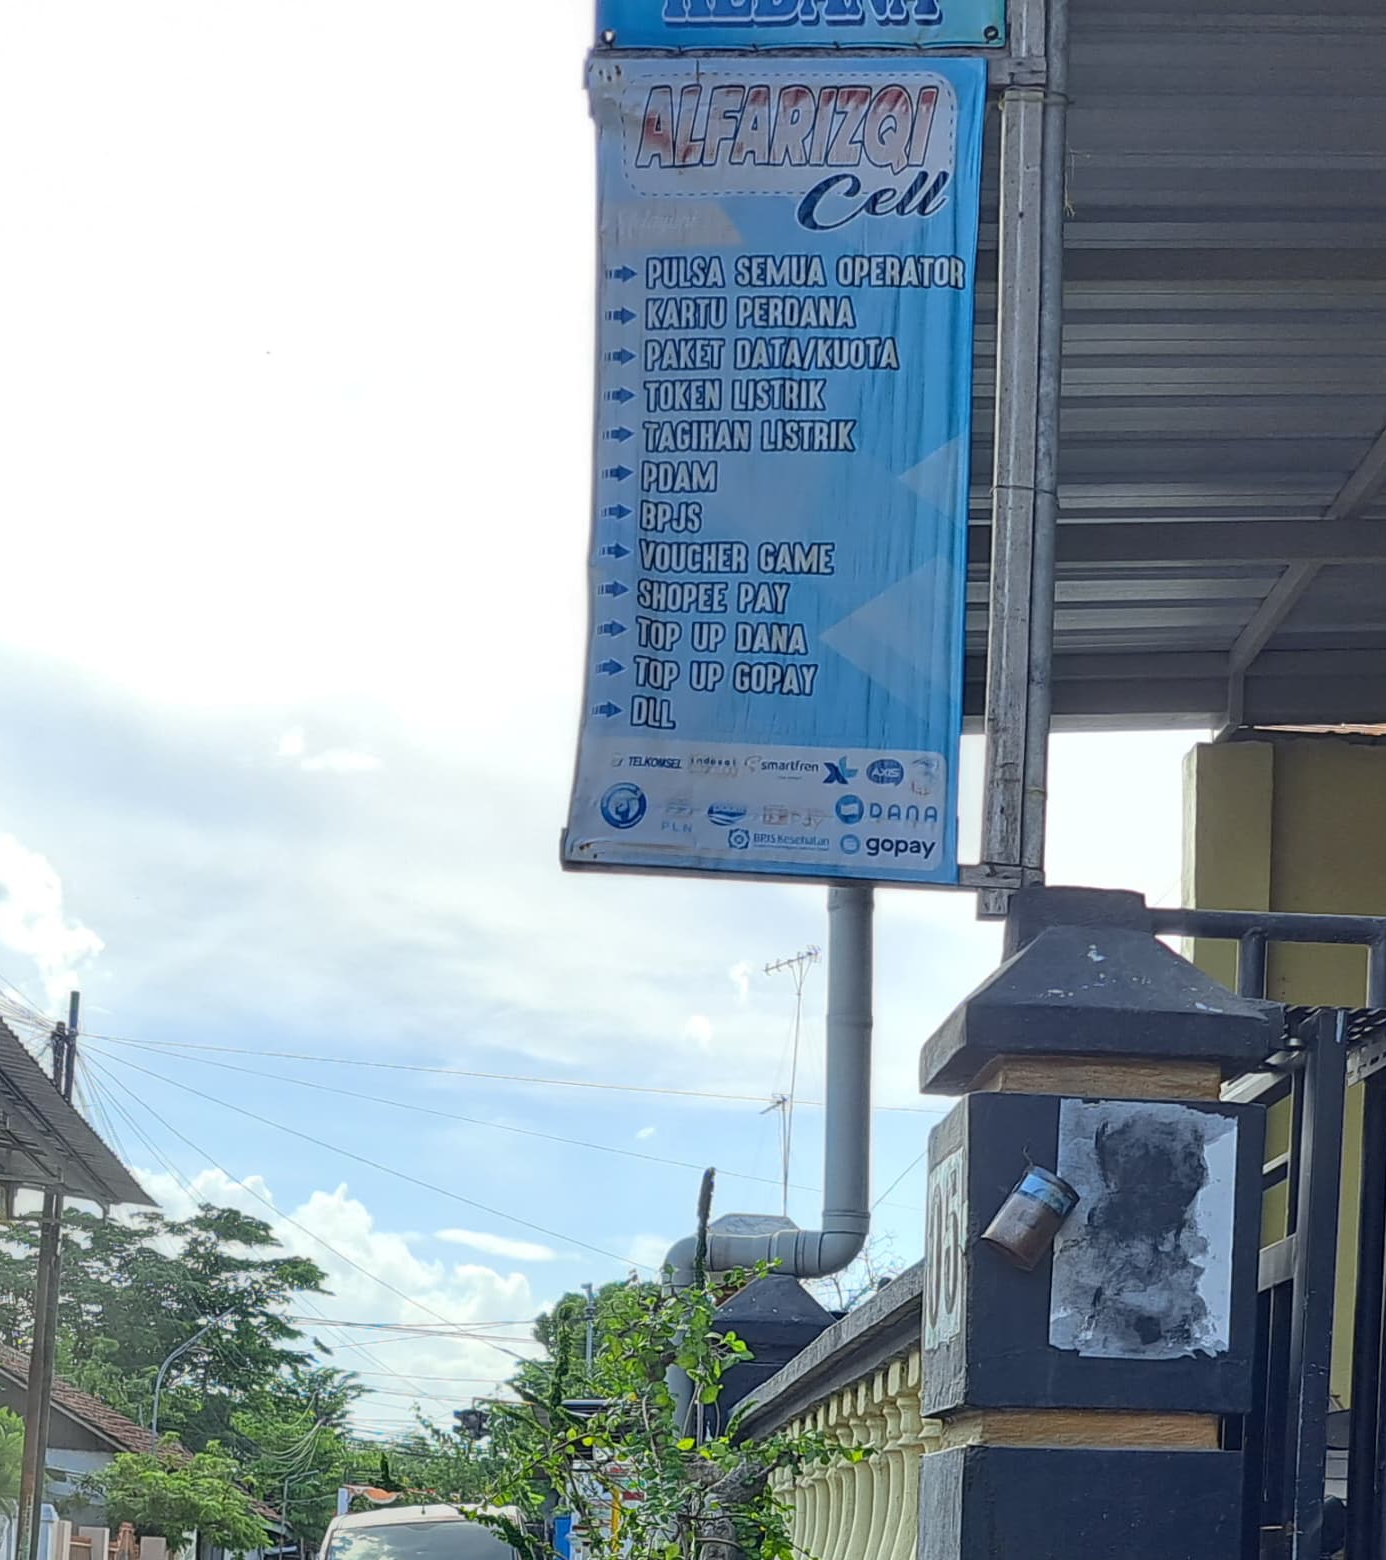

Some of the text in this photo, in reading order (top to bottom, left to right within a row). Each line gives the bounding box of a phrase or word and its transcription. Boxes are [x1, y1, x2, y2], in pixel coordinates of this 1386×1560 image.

[635, 85, 939, 174] ALFARIZQI
[797, 171, 949, 230] Cell
[646, 255, 965, 289] PULSA SEMUA OPERATOR
[645, 296, 856, 329] KARTU PERDANA
[644, 337, 899, 371] PAKET DATA/KUOTA
[643, 378, 827, 412] TOKEN LISTRIK
[643, 420, 857, 451] TAGIHAN LISTRIK
[641, 461, 717, 492] PDAM
[640, 501, 703, 533] BPJS
[639, 539, 835, 575] VOUCHER GAME
[637, 578, 790, 614] SHOPEE PAY
[636, 616, 808, 655] TOP UP DANA
[634, 656, 818, 696] TOP UP GOPAY
[631, 695, 676, 730] DLL
[628, 756, 682, 769] TELKOMSEL
[760, 759, 819, 774] smartfren
[869, 802, 938, 822] DANA
[865, 835, 936, 859] gopay
